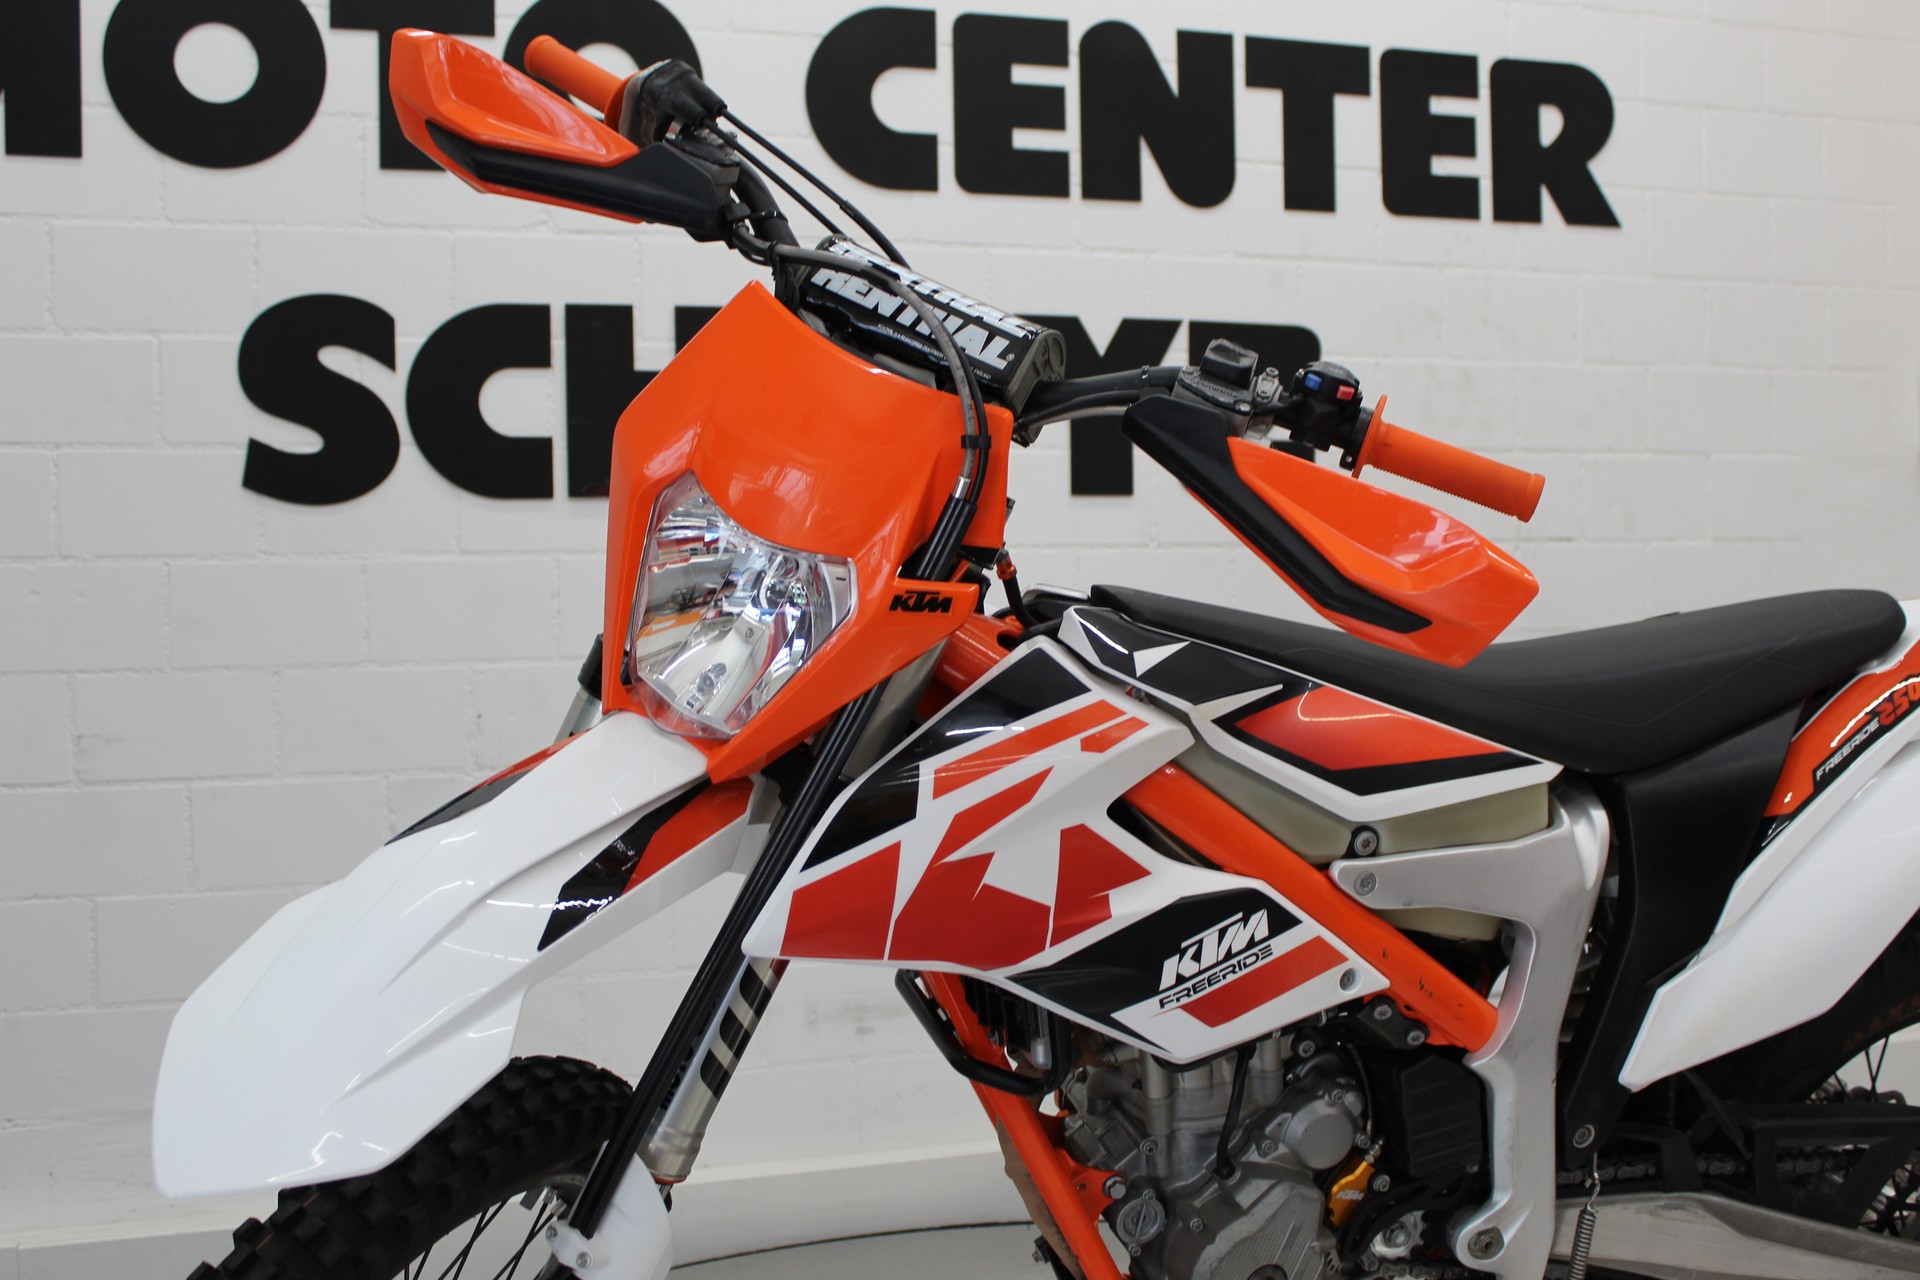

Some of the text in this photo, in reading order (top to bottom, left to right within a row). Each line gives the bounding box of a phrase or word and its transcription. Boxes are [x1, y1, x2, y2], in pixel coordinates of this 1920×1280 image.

[805, 6, 1621, 228] CENTER
[810, 267, 1010, 370] RENTHAL
[889, 590, 953, 614] KTM
[1816, 677, 1920, 782] FREERIDE 250
[1158, 944, 1273, 1009] FREERIDE
[1159, 908, 1270, 991] KTM
